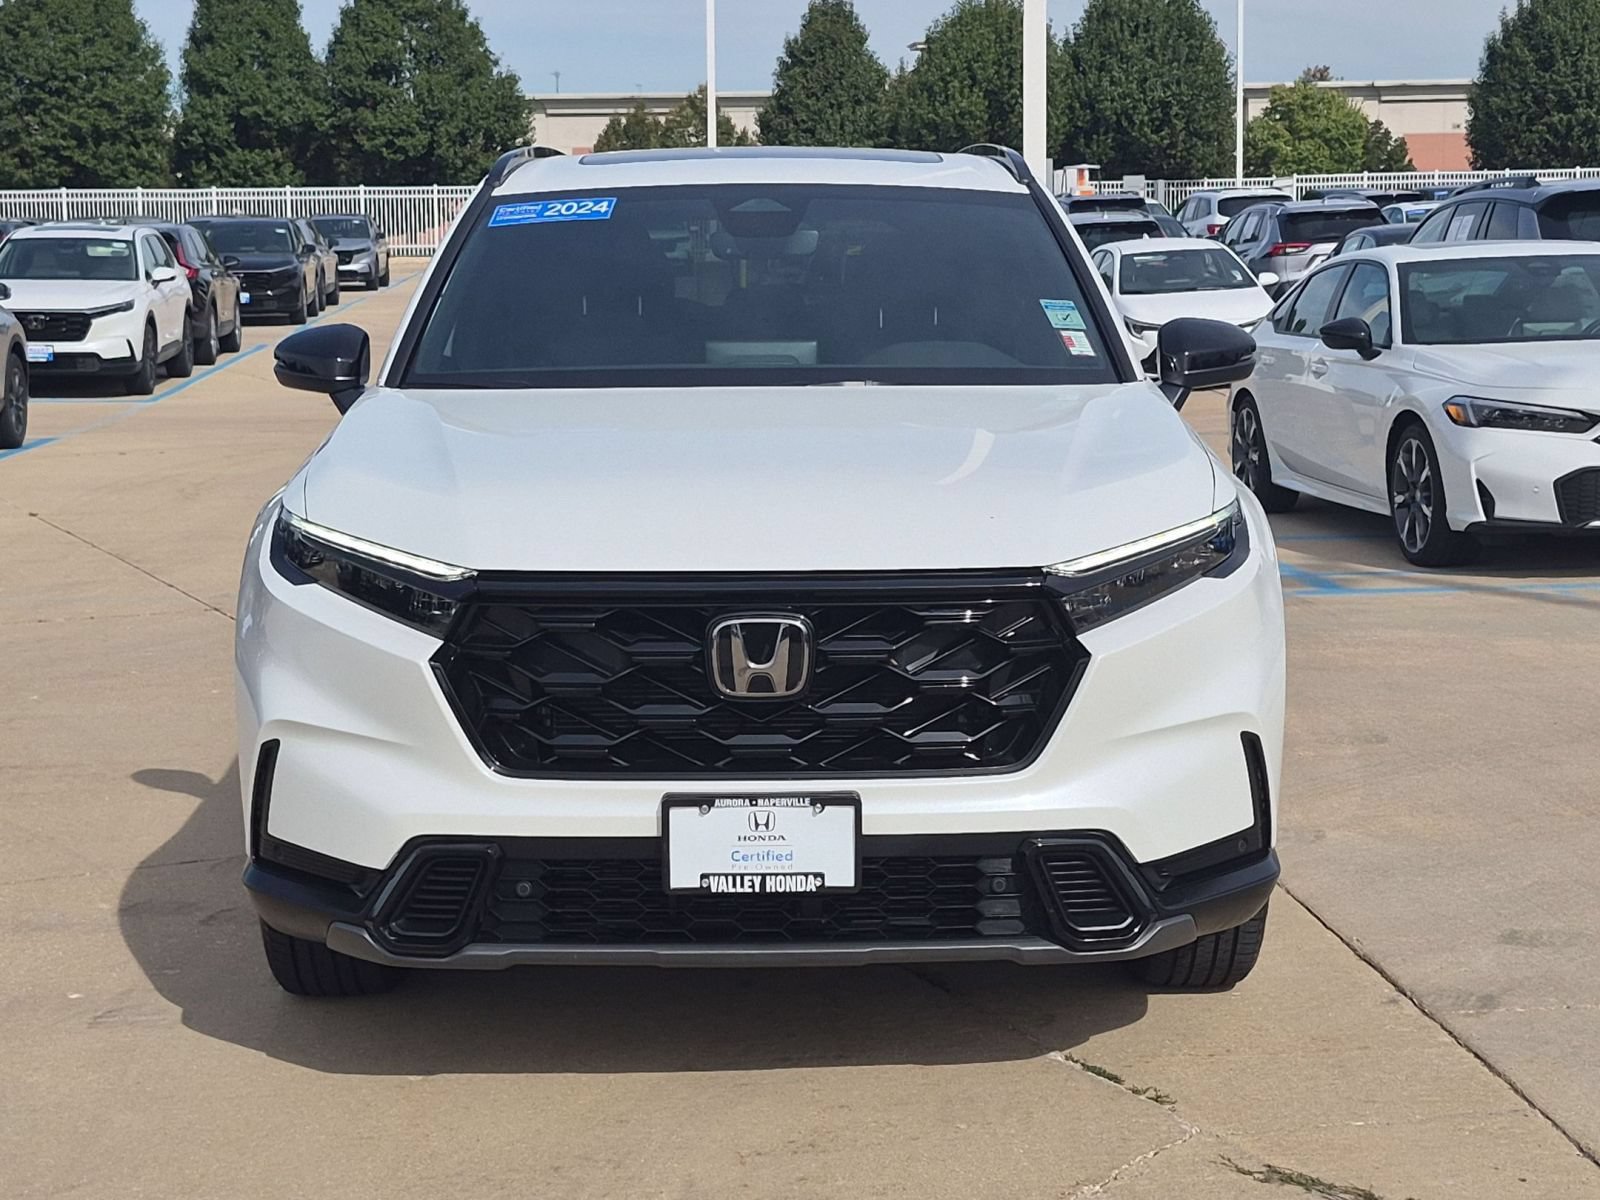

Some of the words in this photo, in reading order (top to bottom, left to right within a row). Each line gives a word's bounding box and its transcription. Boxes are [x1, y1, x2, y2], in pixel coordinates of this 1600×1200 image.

[544, 201, 609, 216] 2024
[714, 798, 750, 807] AURORA
[757, 798, 811, 807] NAPERVILLE
[731, 850, 793, 862] Certified
[709, 875, 762, 893] VALLEY
[765, 875, 817, 892] HONDA
